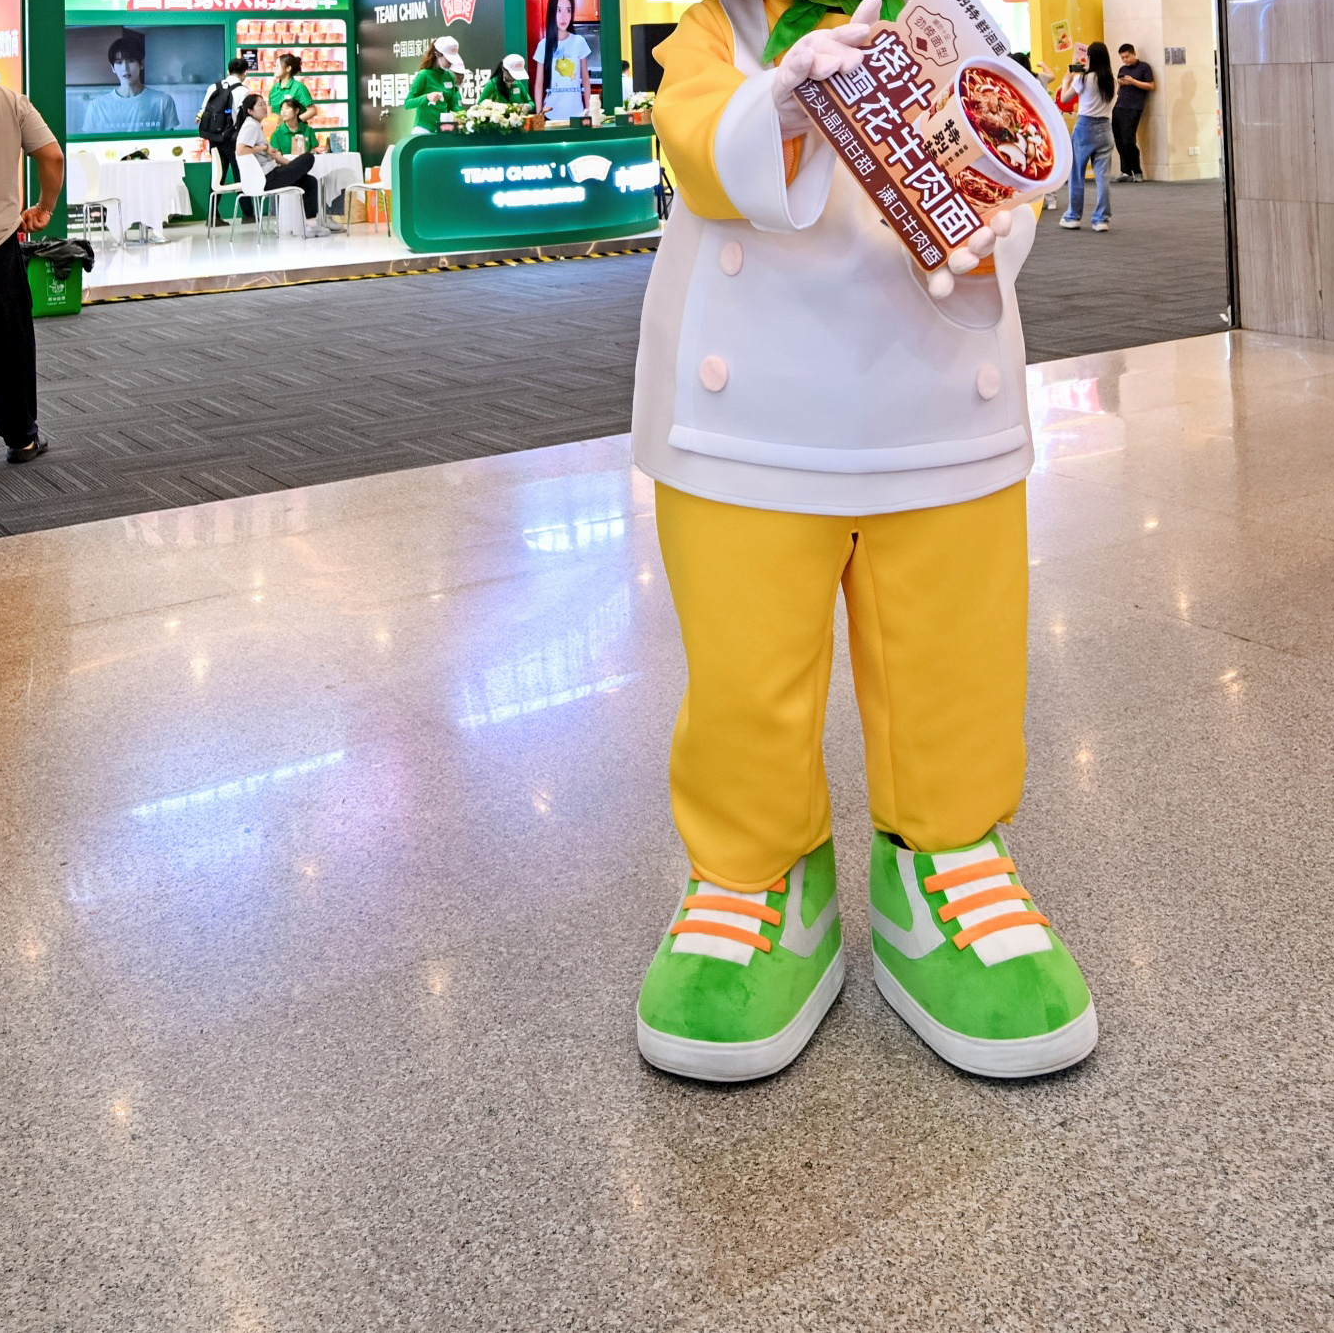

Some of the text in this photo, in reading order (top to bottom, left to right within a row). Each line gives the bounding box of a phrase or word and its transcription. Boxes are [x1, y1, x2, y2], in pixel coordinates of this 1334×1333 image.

[374, 0, 428, 24] TEAM CHINA
[975, 19, 1007, 56] 鲜泡面
[861, 32, 931, 112] 烧汁
[828, 64, 980, 246] 雪花牛肉面
[875, 183, 944, 267] 满口牛肉香
